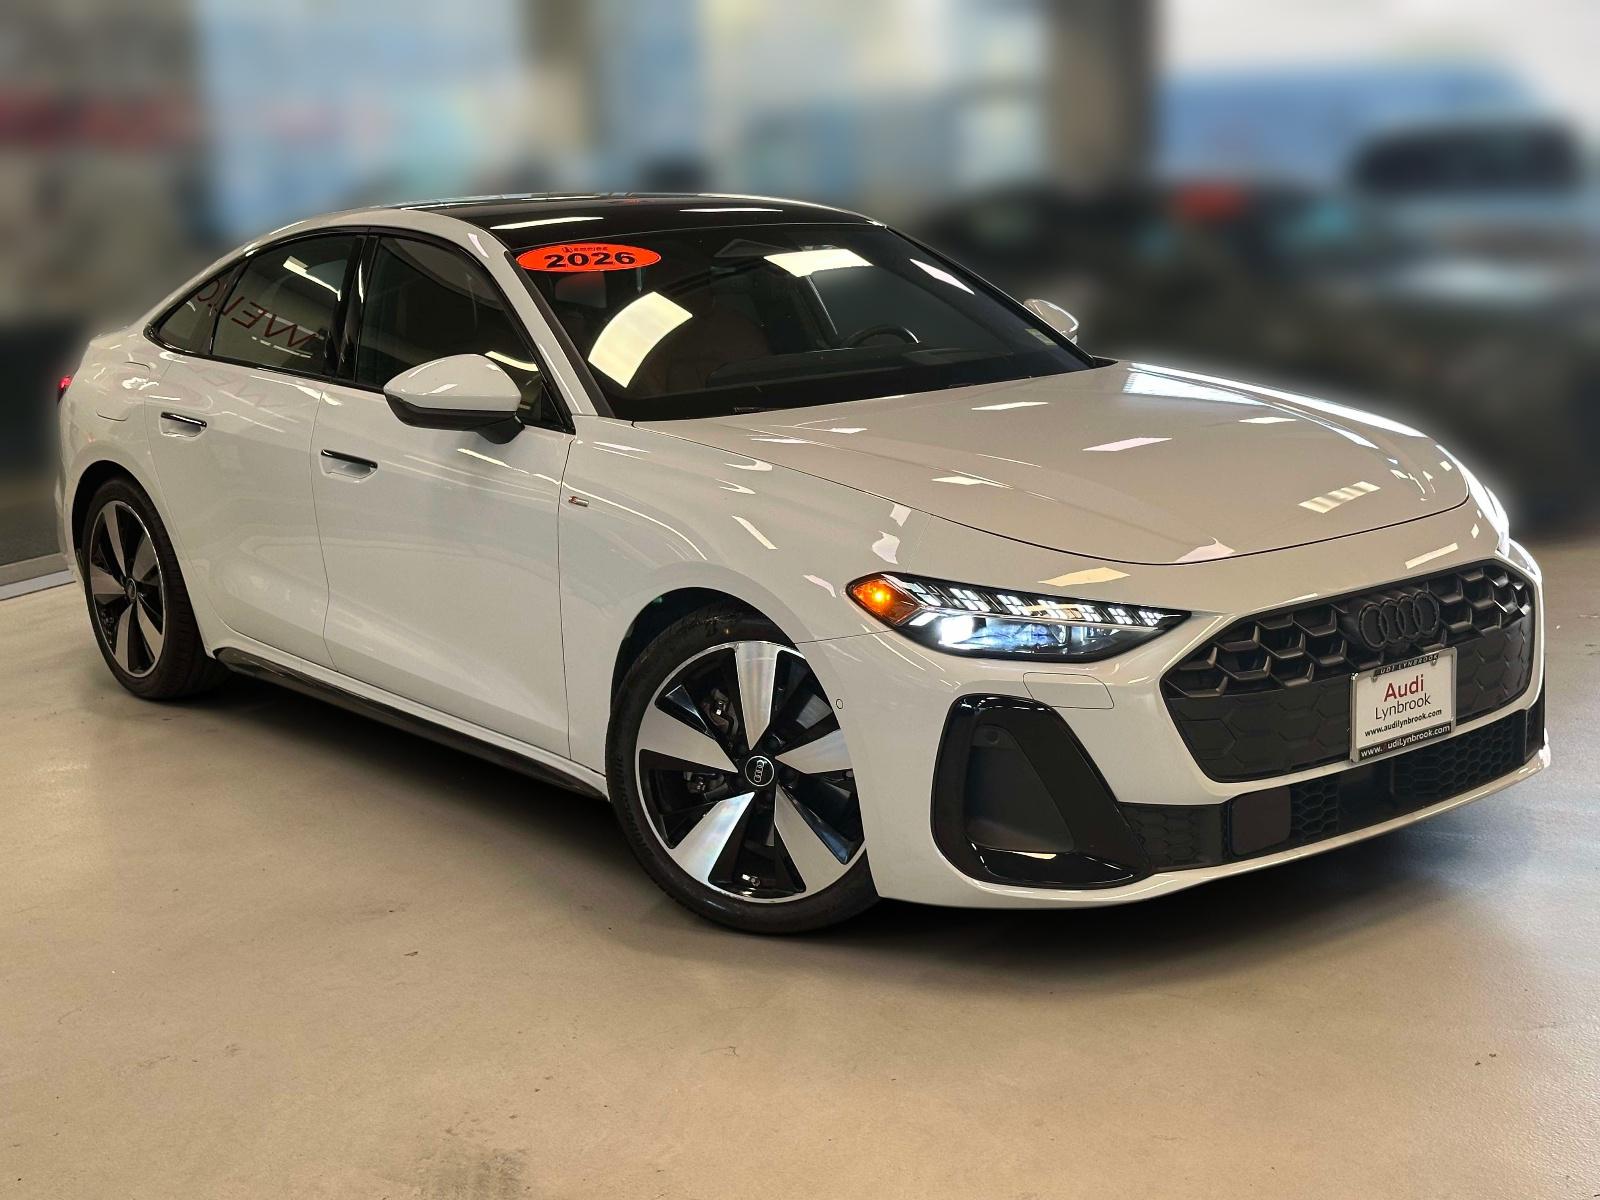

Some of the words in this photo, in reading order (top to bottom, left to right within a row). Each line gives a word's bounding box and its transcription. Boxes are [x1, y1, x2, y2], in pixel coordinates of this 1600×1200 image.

[544, 251, 636, 269] 2026
[1383, 674, 1424, 702] Audi
[1375, 693, 1431, 720] Lynbrook
[1364, 709, 1442, 737] www.audilynbrook.com
